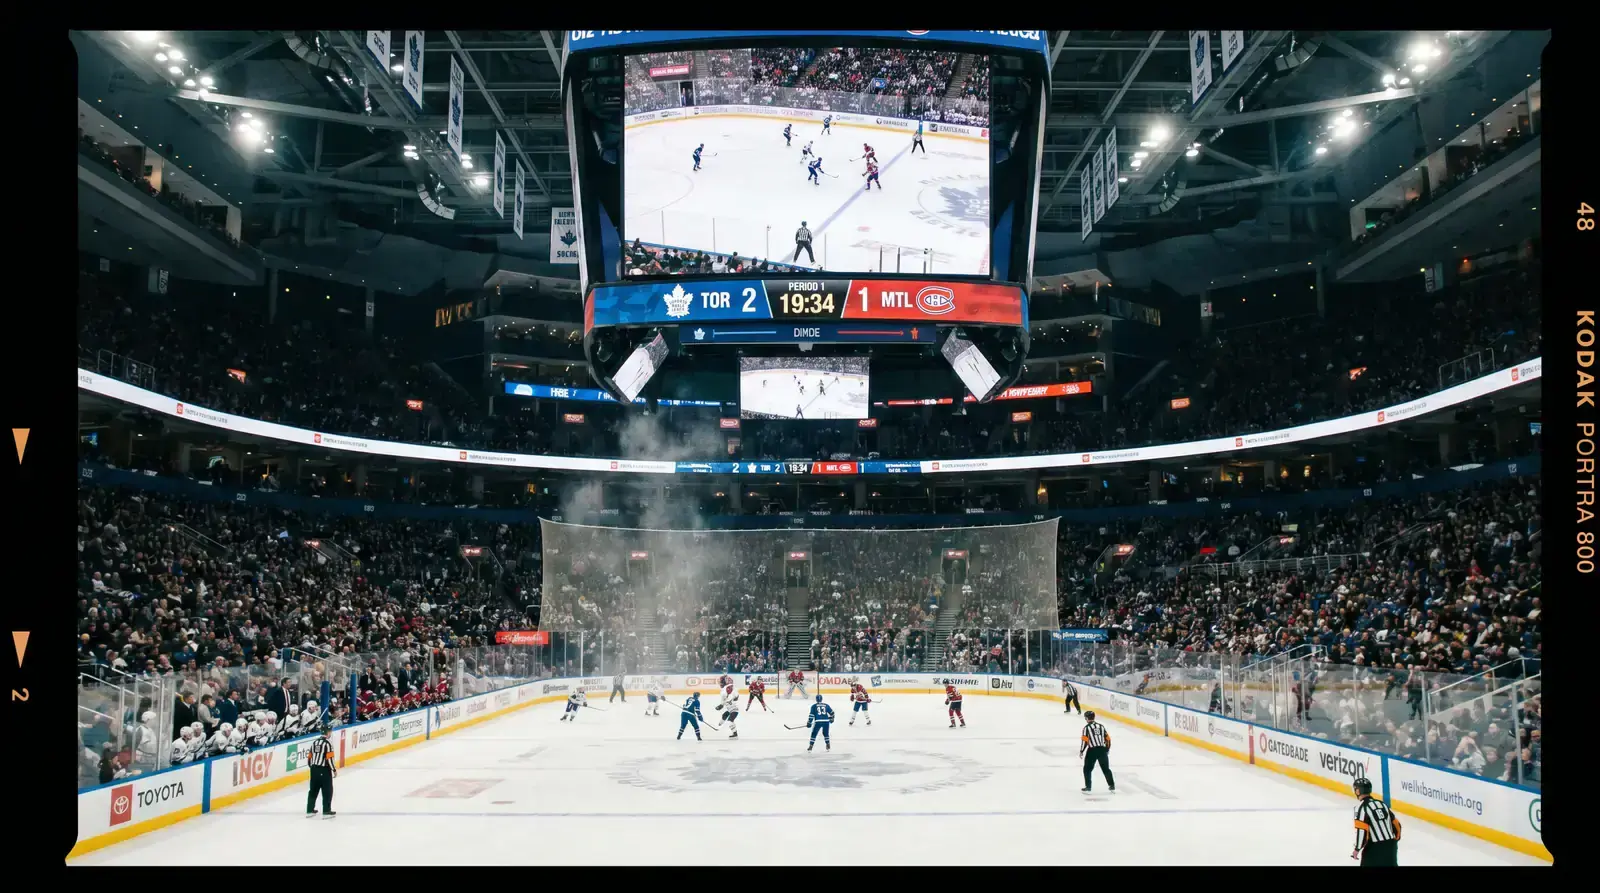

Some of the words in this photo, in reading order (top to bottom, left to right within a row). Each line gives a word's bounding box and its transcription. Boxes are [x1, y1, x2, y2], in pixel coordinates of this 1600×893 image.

[788, 281, 818, 291] PERIOD
[820, 281, 825, 291] 1
[858, 286, 869, 312] 1
[881, 291, 914, 308] MTL
[701, 291, 731, 309] TOR
[742, 287, 757, 313] 2
[780, 293, 835, 314] 19:34
[1268, 738, 1309, 763] GATEDBADE
[1319, 750, 1365, 779] verizon
[138, 781, 184, 808] TOYOTA
